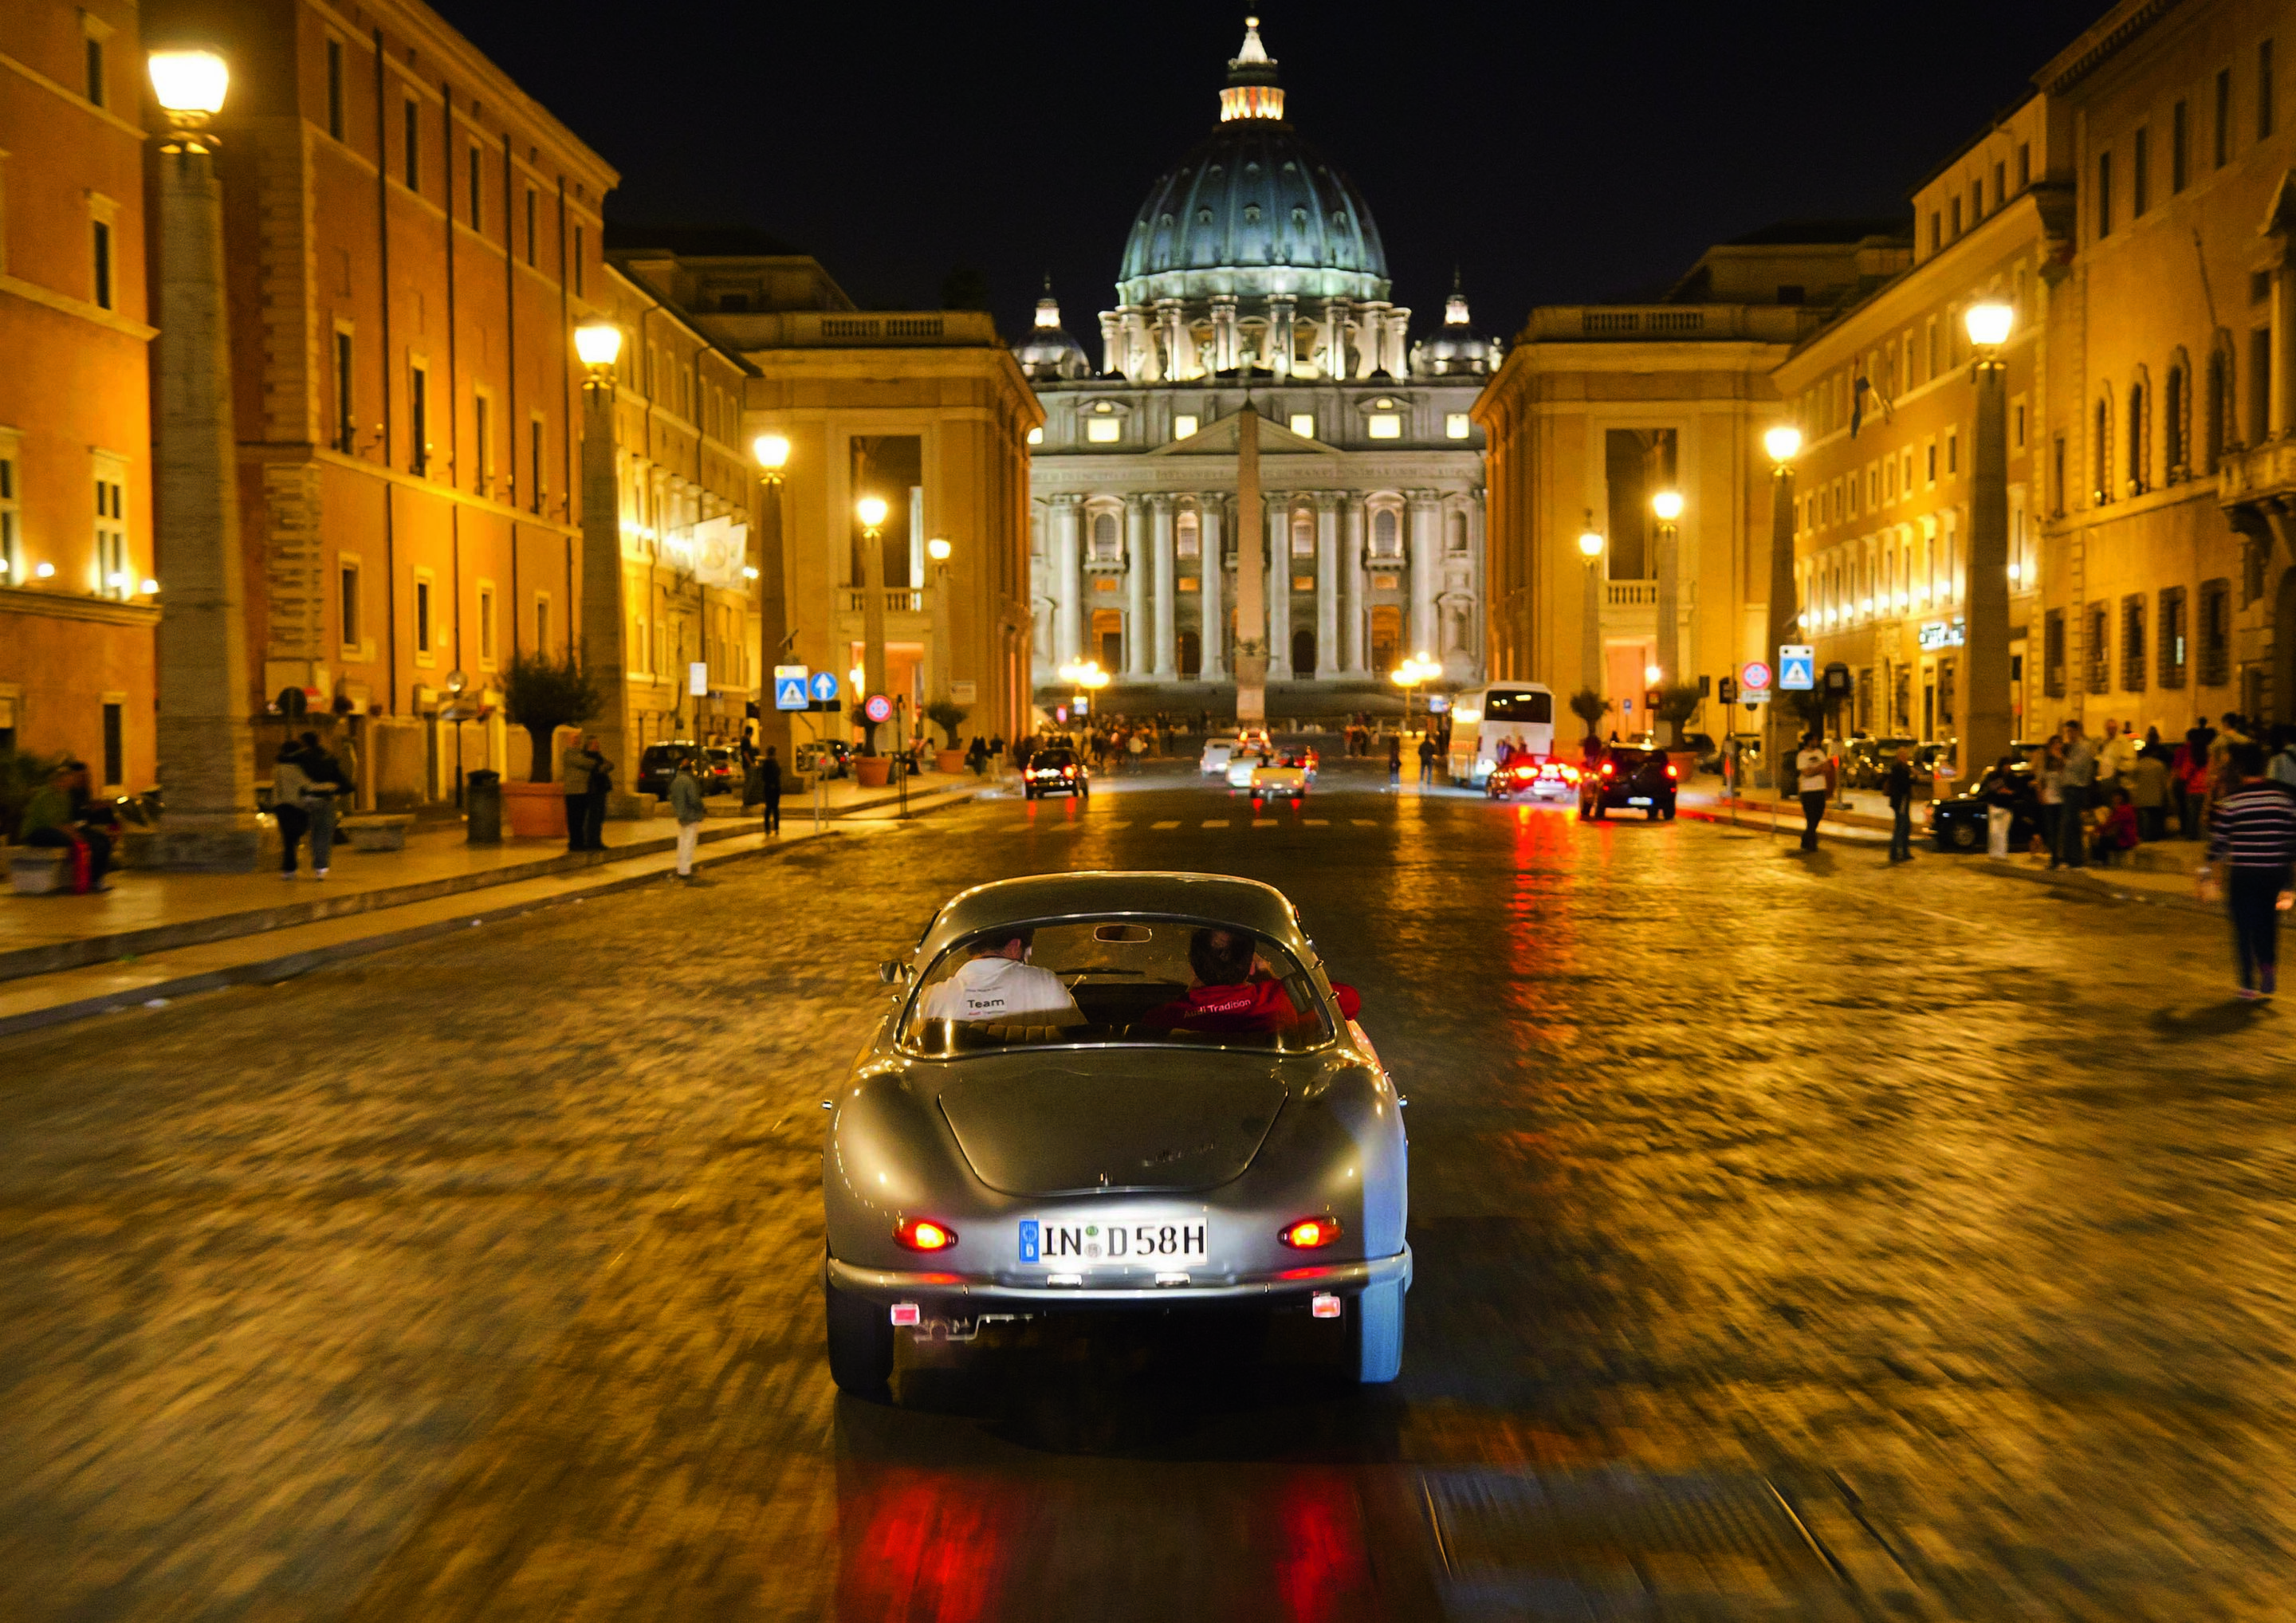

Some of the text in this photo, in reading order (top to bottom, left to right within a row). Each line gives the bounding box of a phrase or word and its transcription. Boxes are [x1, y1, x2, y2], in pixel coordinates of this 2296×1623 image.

[966, 999, 1005, 1008] Team
[1207, 999, 1251, 1012] Tradition
[1041, 1227, 1081, 1256] IN
[1107, 1227, 1127, 1256] D
[1137, 1226, 1204, 1255] 58H
